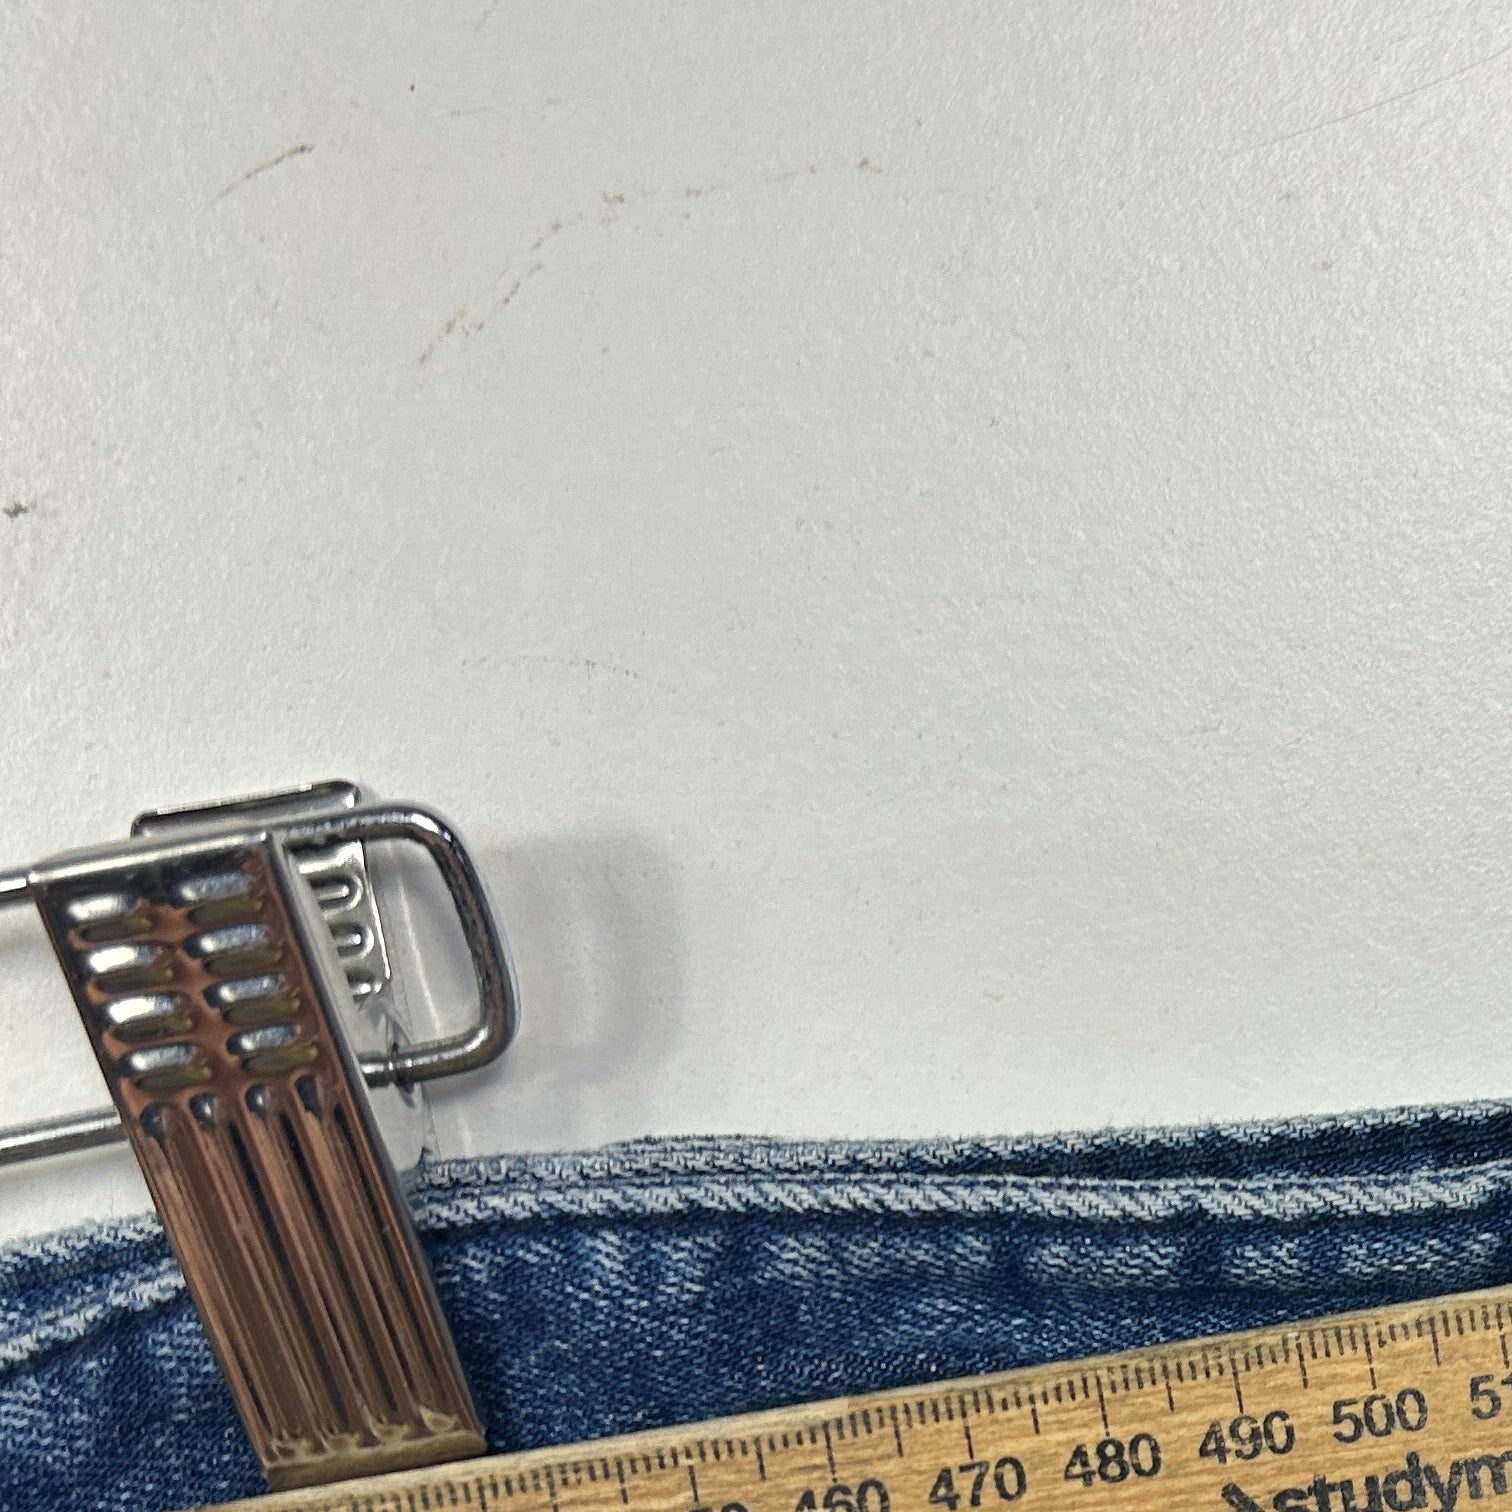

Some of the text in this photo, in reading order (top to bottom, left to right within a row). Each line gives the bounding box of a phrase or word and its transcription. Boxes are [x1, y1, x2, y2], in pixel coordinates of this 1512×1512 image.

[928, 1457, 1026, 1511] 470
[1064, 1433, 1162, 1487] 480
[1200, 1410, 1295, 1465] 490
[1331, 1387, 1428, 1444] 500
